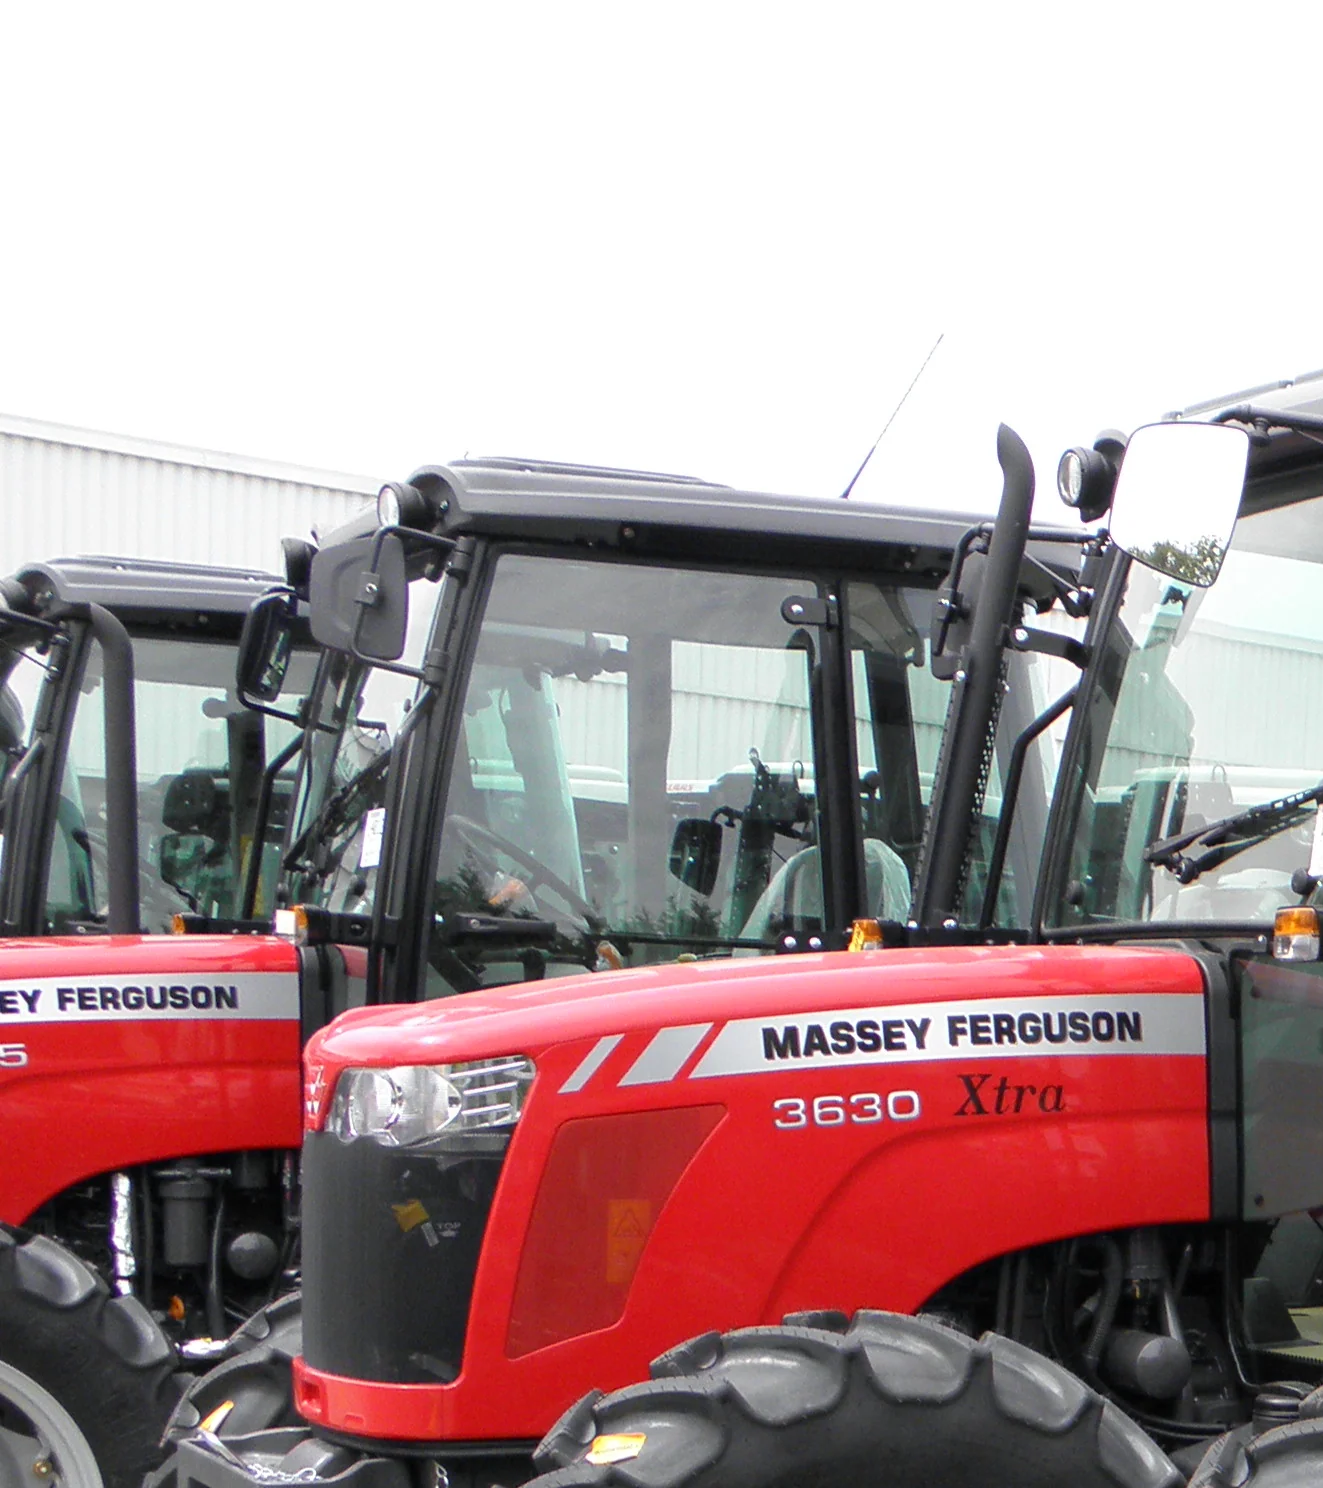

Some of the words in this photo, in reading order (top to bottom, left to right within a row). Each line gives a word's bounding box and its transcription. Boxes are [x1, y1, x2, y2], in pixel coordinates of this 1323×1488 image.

[57, 986, 239, 1011] FERGUSON
[761, 1016, 932, 1061] MASSEY
[948, 1010, 1144, 1047] FERGUSON
[772, 1089, 922, 1129] 3630
[953, 1073, 1066, 1117] Xtra
